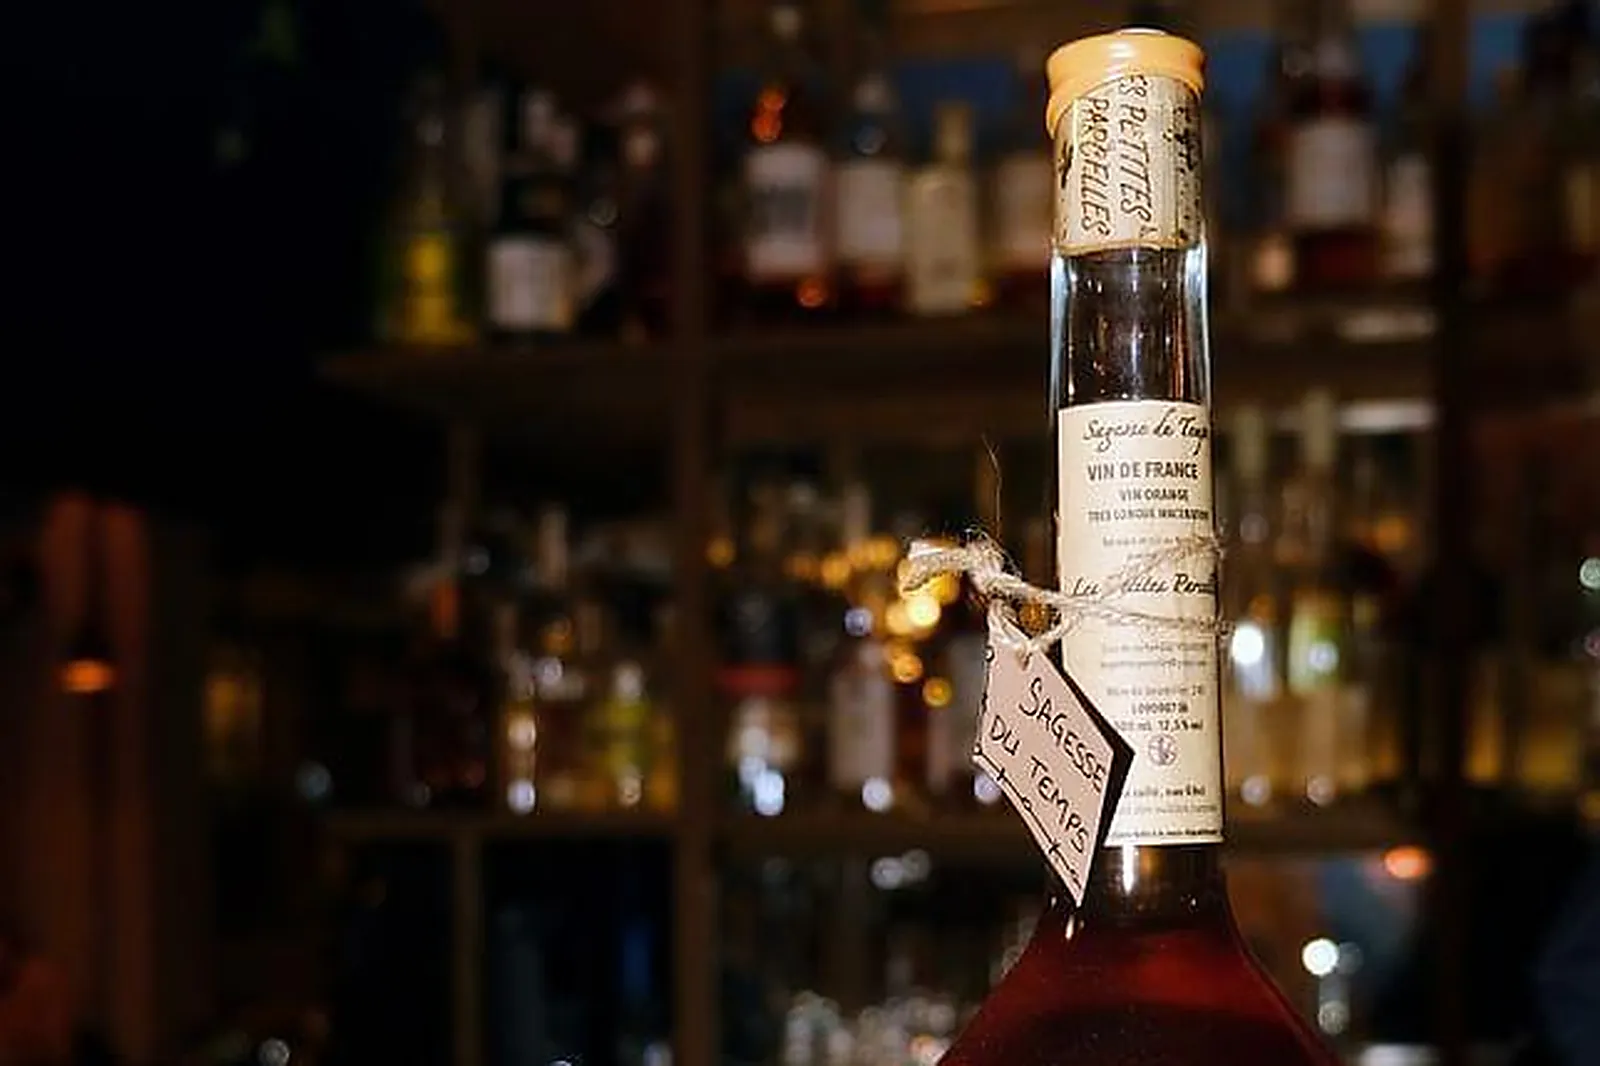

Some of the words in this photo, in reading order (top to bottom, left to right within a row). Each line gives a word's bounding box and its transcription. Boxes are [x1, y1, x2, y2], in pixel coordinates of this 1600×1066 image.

[1078, 98, 1111, 236] PARCELLES
[1119, 103, 1153, 223] PETITES
[1087, 461, 1115, 482] VIN
[1119, 461, 1141, 479] DE
[1144, 461, 1199, 481] FRANCE
[1120, 488, 1142, 502] VIN
[991, 715, 1020, 756] DU
[1030, 755, 1090, 854] TEMPS
[1019, 677, 1107, 794] SAGESSE
